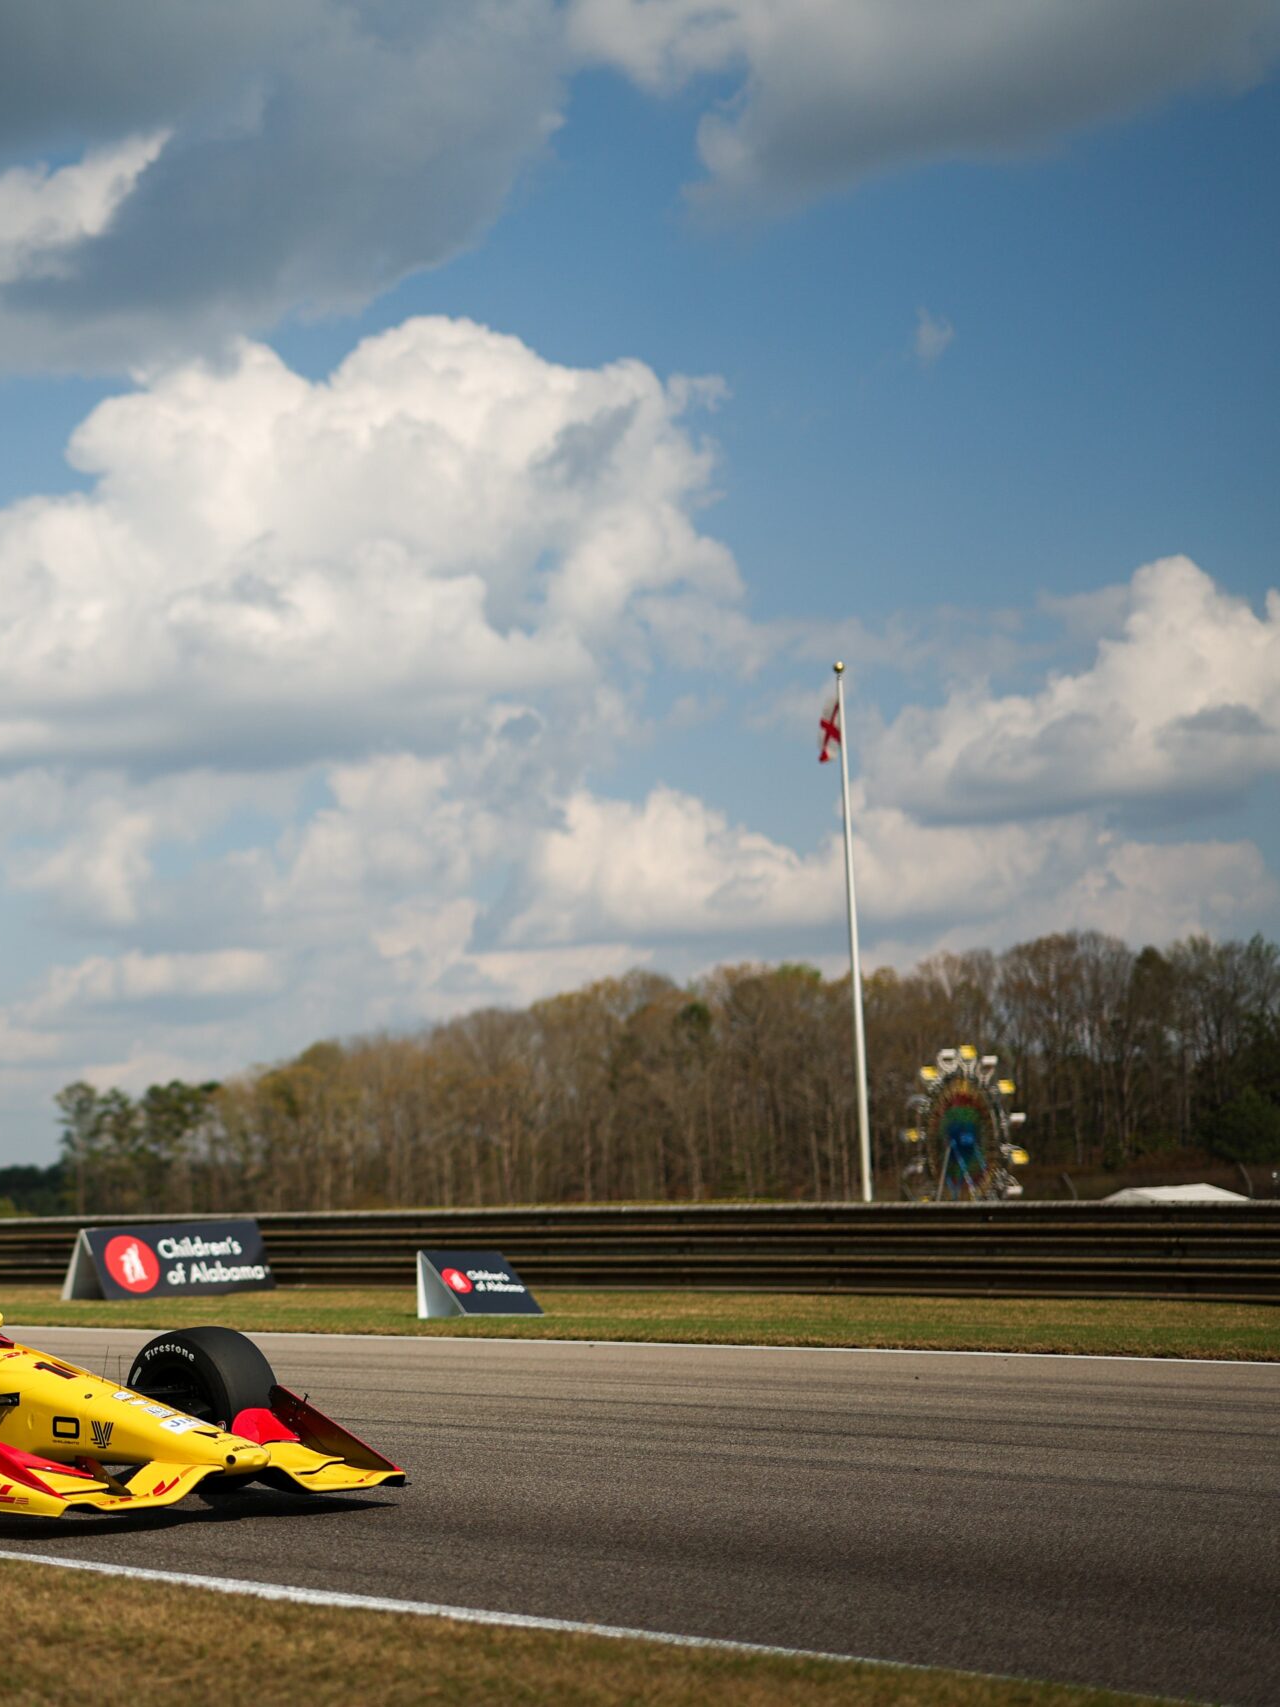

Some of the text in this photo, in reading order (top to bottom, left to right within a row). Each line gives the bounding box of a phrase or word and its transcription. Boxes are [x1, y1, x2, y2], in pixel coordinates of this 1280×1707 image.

[157, 1235, 242, 1259] Children's
[167, 1260, 265, 1285] of Alabama
[466, 1270, 510, 1281] Children's
[475, 1281, 486, 1292] of
[144, 1343, 195, 1362] Firestone
